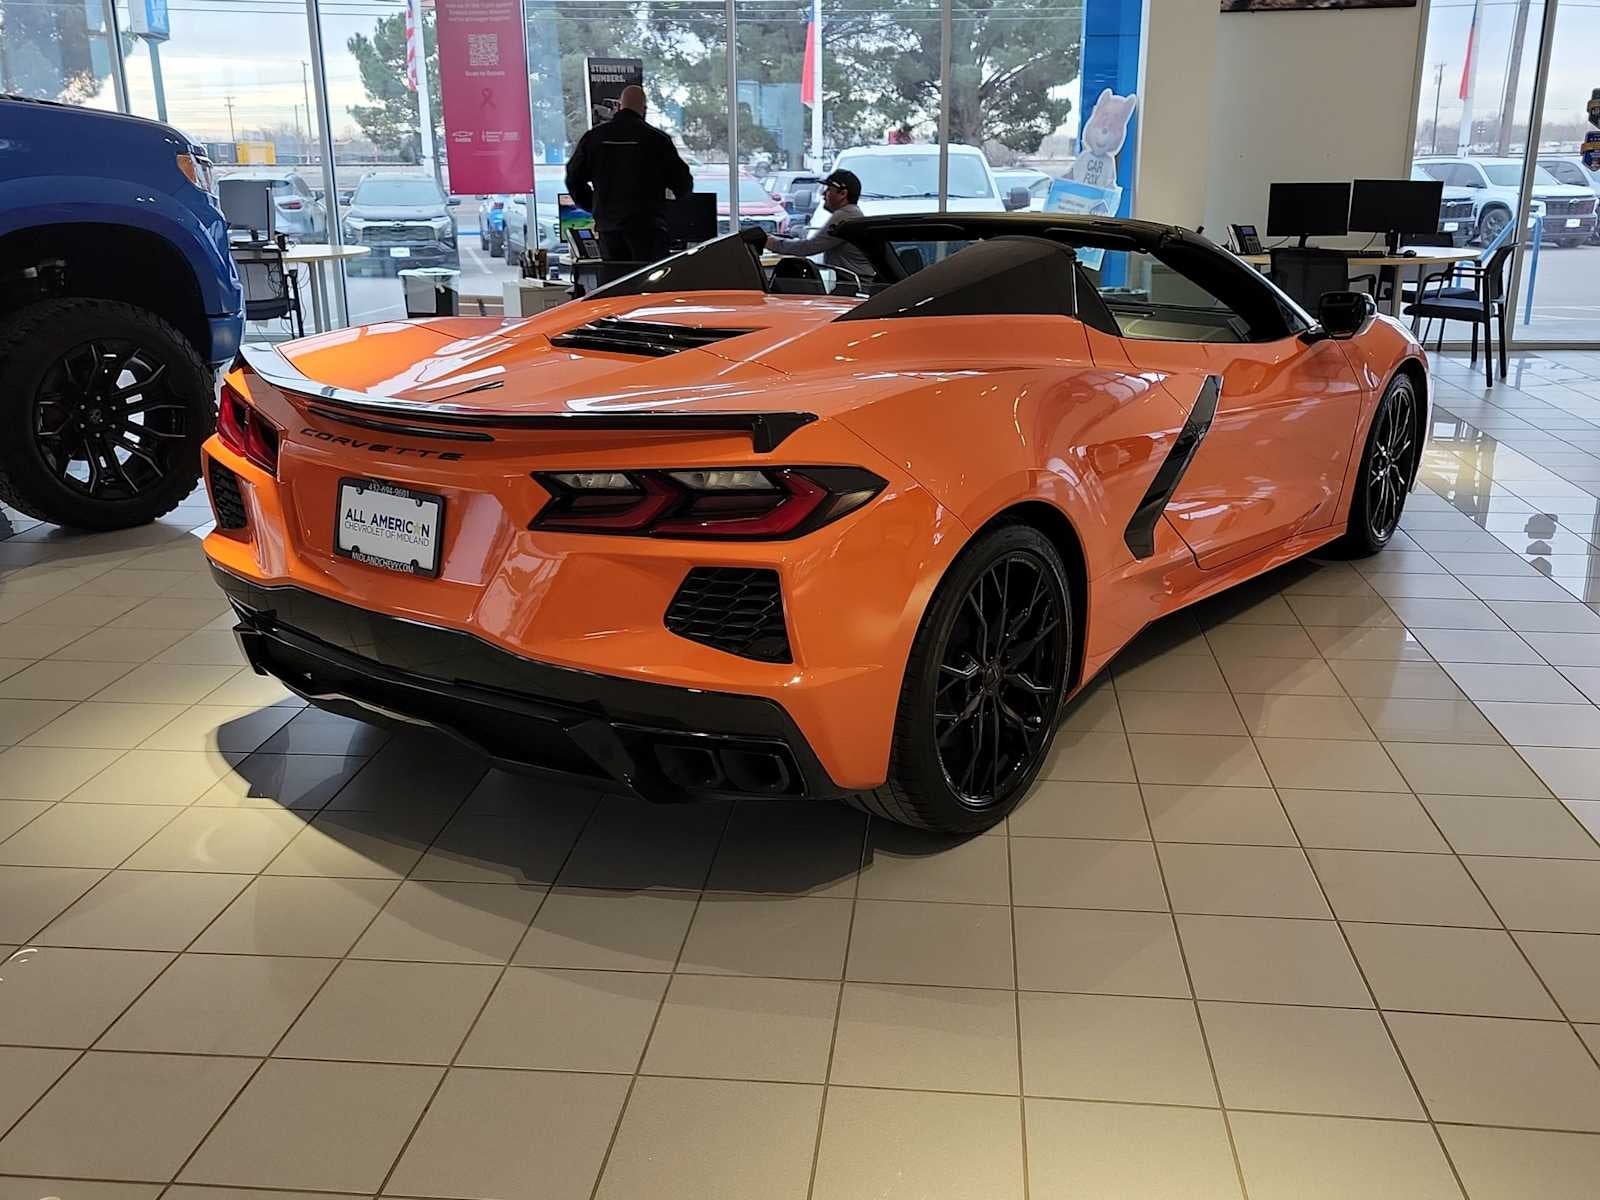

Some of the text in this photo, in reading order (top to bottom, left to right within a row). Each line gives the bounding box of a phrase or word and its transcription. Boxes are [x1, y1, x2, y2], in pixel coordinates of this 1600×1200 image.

[591, 64, 625, 73] STRENGTH
[1087, 159, 1104, 174] CAR
[1083, 173, 1100, 185] FOX
[300, 428, 465, 461] CORVETTE
[345, 508, 366, 524] ALL
[344, 521, 430, 547] CHEVROLET OF MIDLAND
[351, 551, 415, 574] MIDLANDCHEVY.COM
